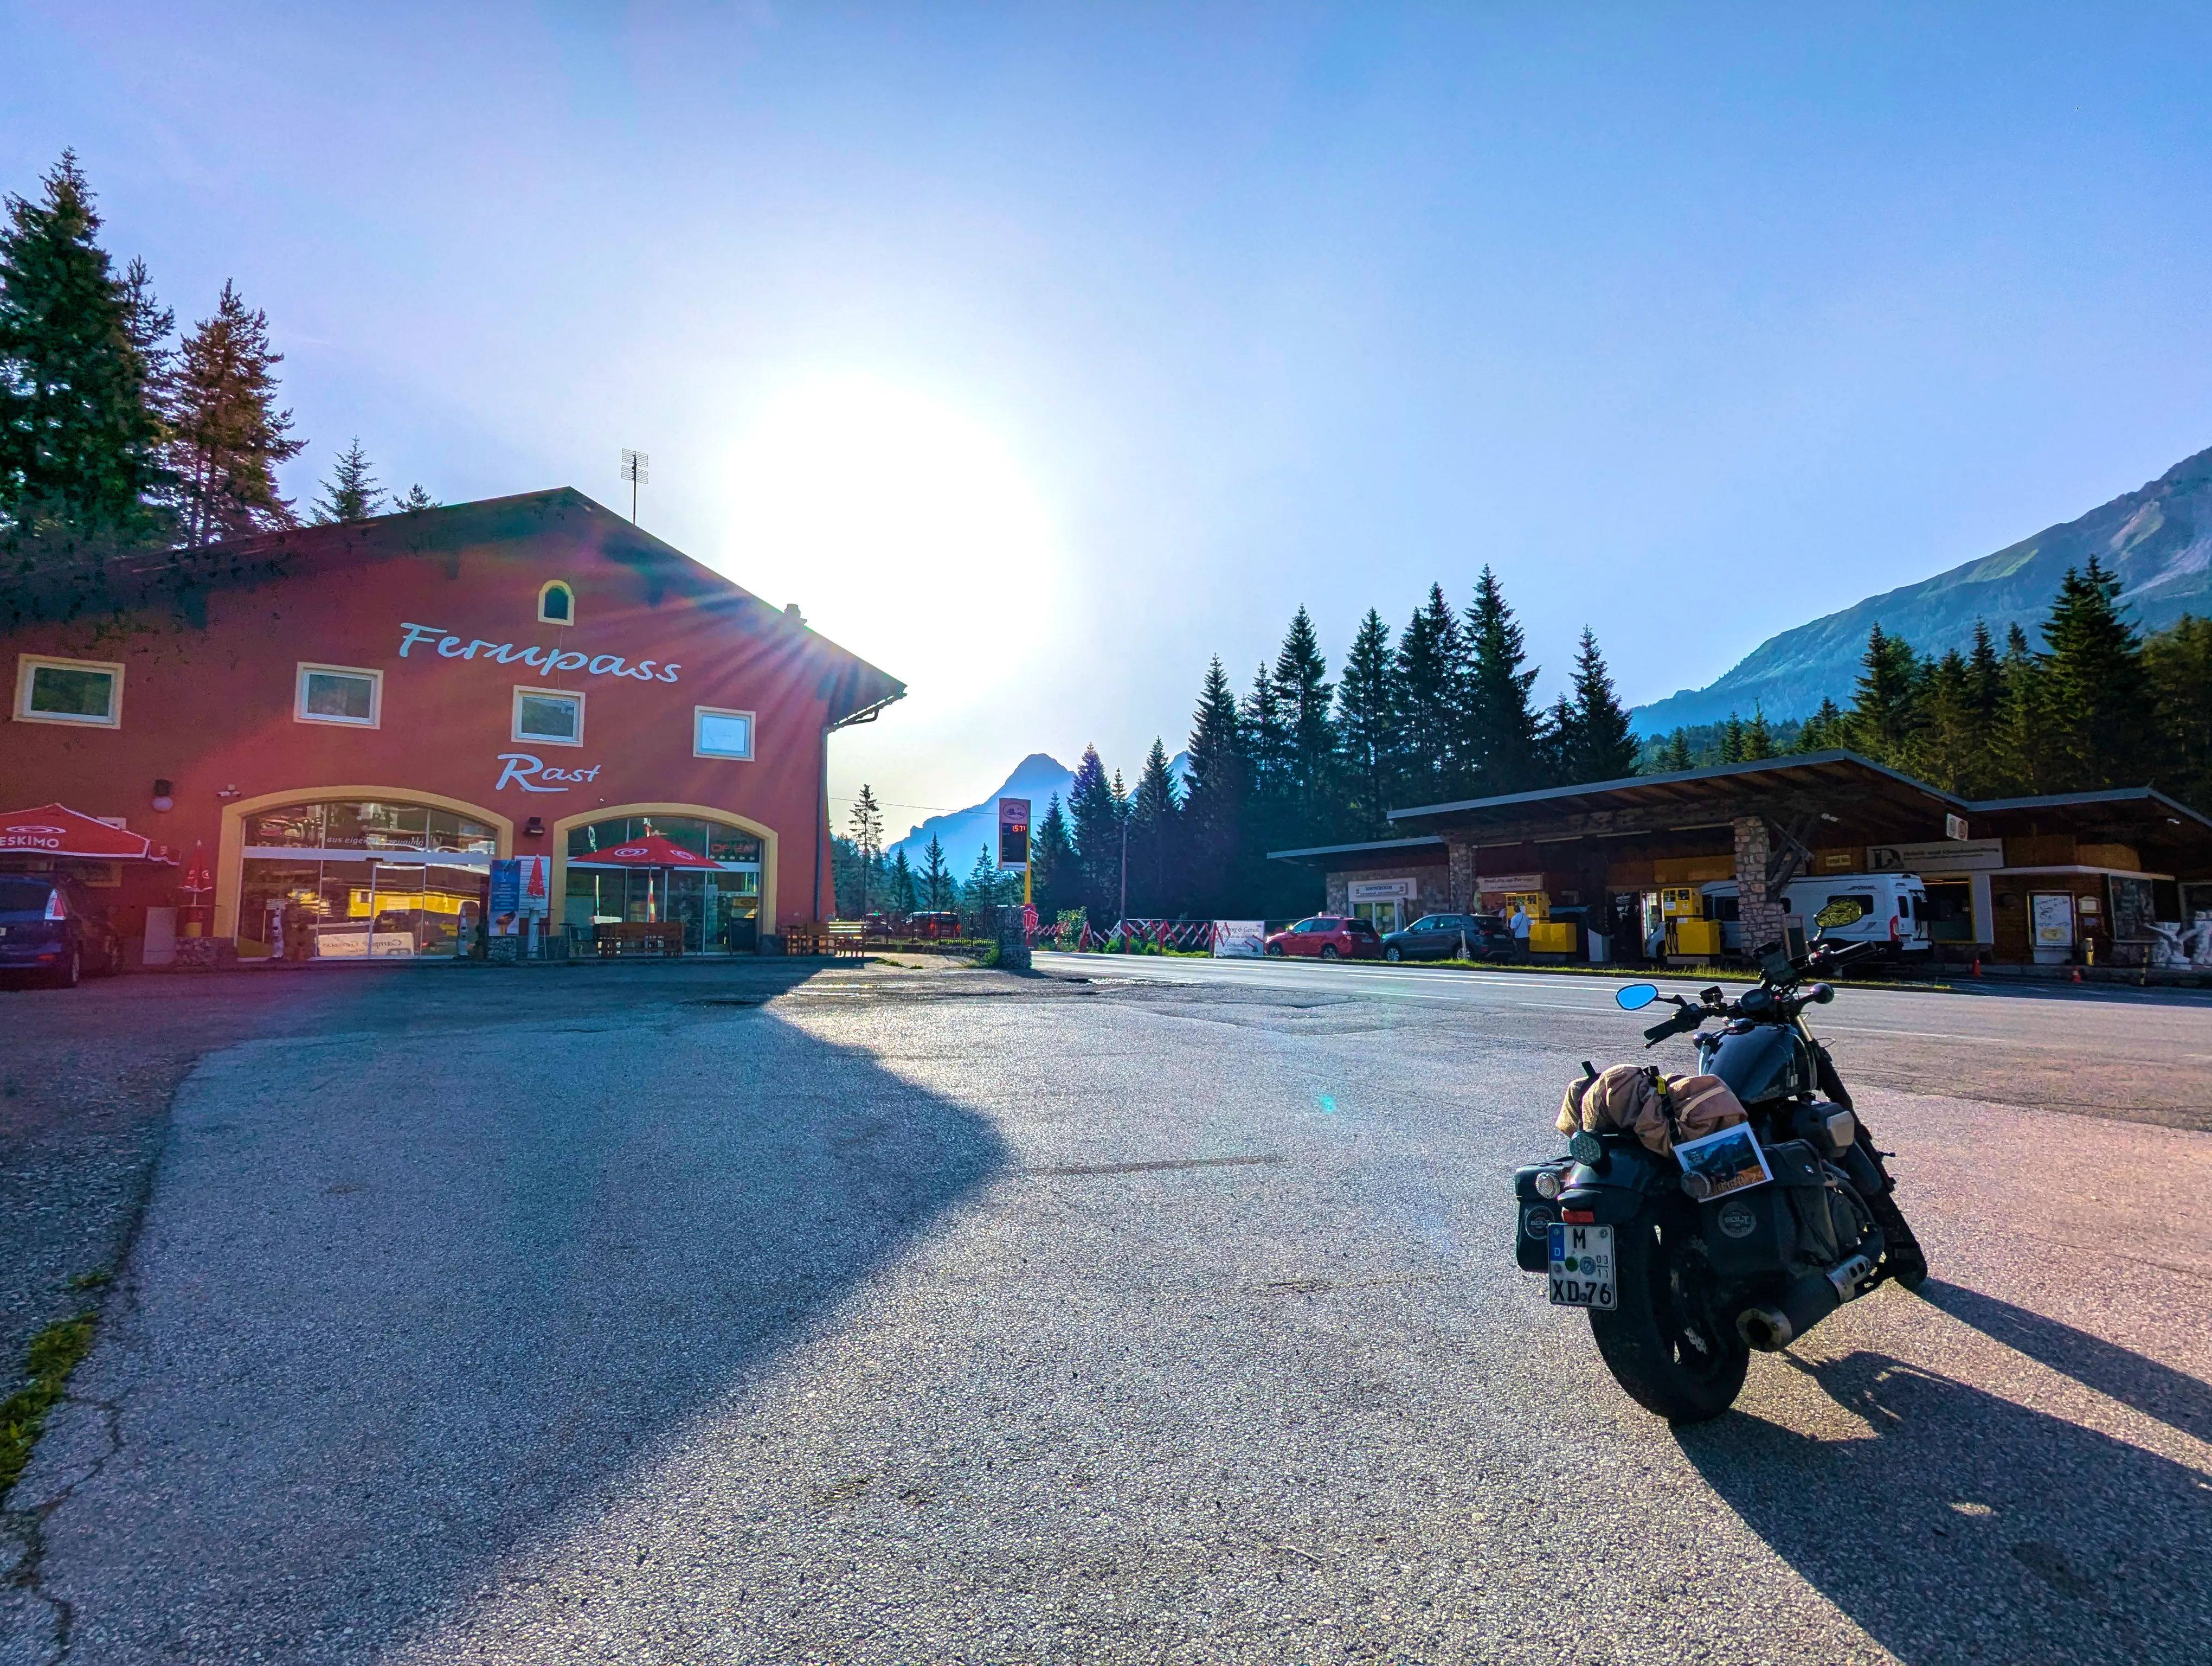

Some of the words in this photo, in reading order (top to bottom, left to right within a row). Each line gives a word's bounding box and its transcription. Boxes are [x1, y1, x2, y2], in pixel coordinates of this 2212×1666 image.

[398, 622, 682, 683] Fernpass
[496, 753, 601, 792] Rast
[0, 835, 60, 848] ESKIMO
[1573, 1228, 1586, 1249] M
[1554, 1247, 1561, 1256] D
[1596, 1255, 1609, 1264] 03
